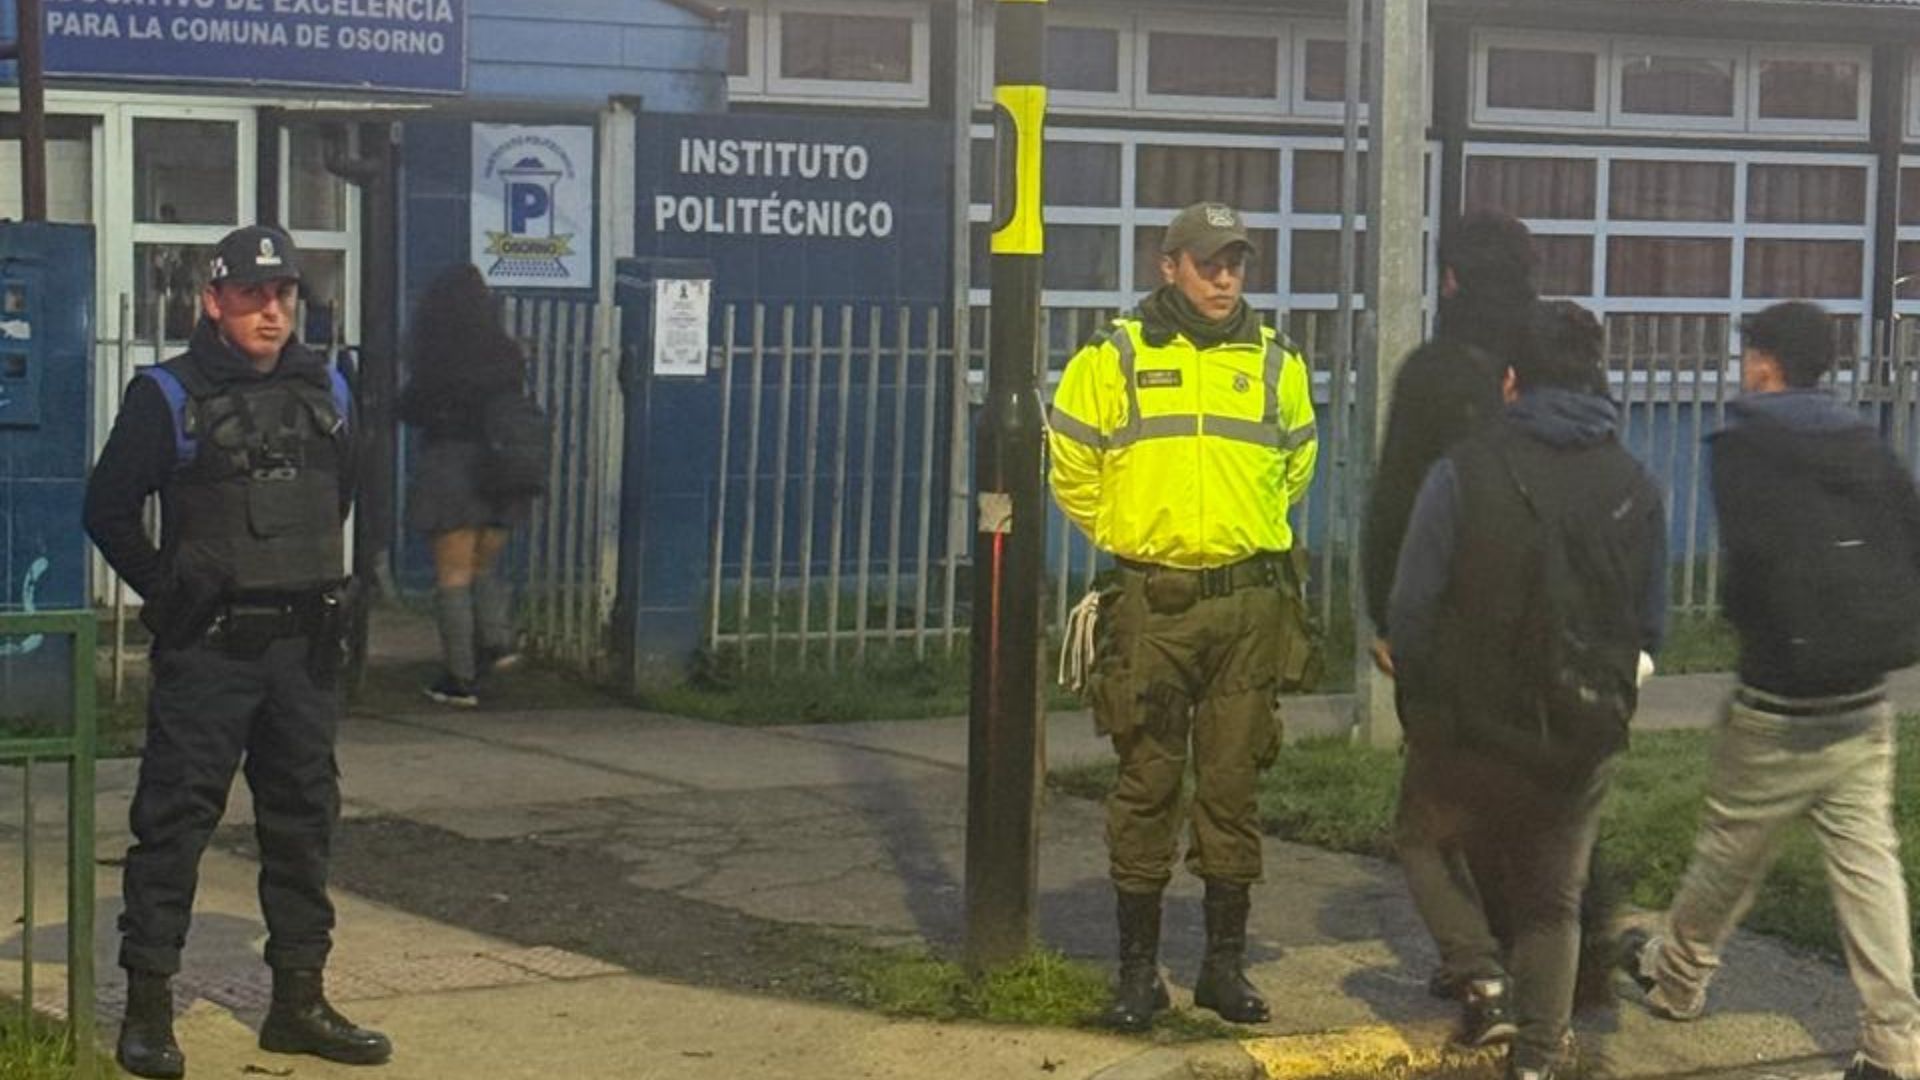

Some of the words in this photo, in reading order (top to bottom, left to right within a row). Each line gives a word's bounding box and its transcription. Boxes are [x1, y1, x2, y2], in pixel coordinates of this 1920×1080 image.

[47, 12, 120, 37] PARA
[129, 15, 163, 39] LA
[171, 17, 287, 46] COMUNA
[296, 24, 330, 48] DE
[338, 27, 444, 55] OSORNO
[680, 138, 868, 180] INSTITUTO
[511, 183, 549, 233] P
[655, 191, 893, 237] POLITÉCNICO
